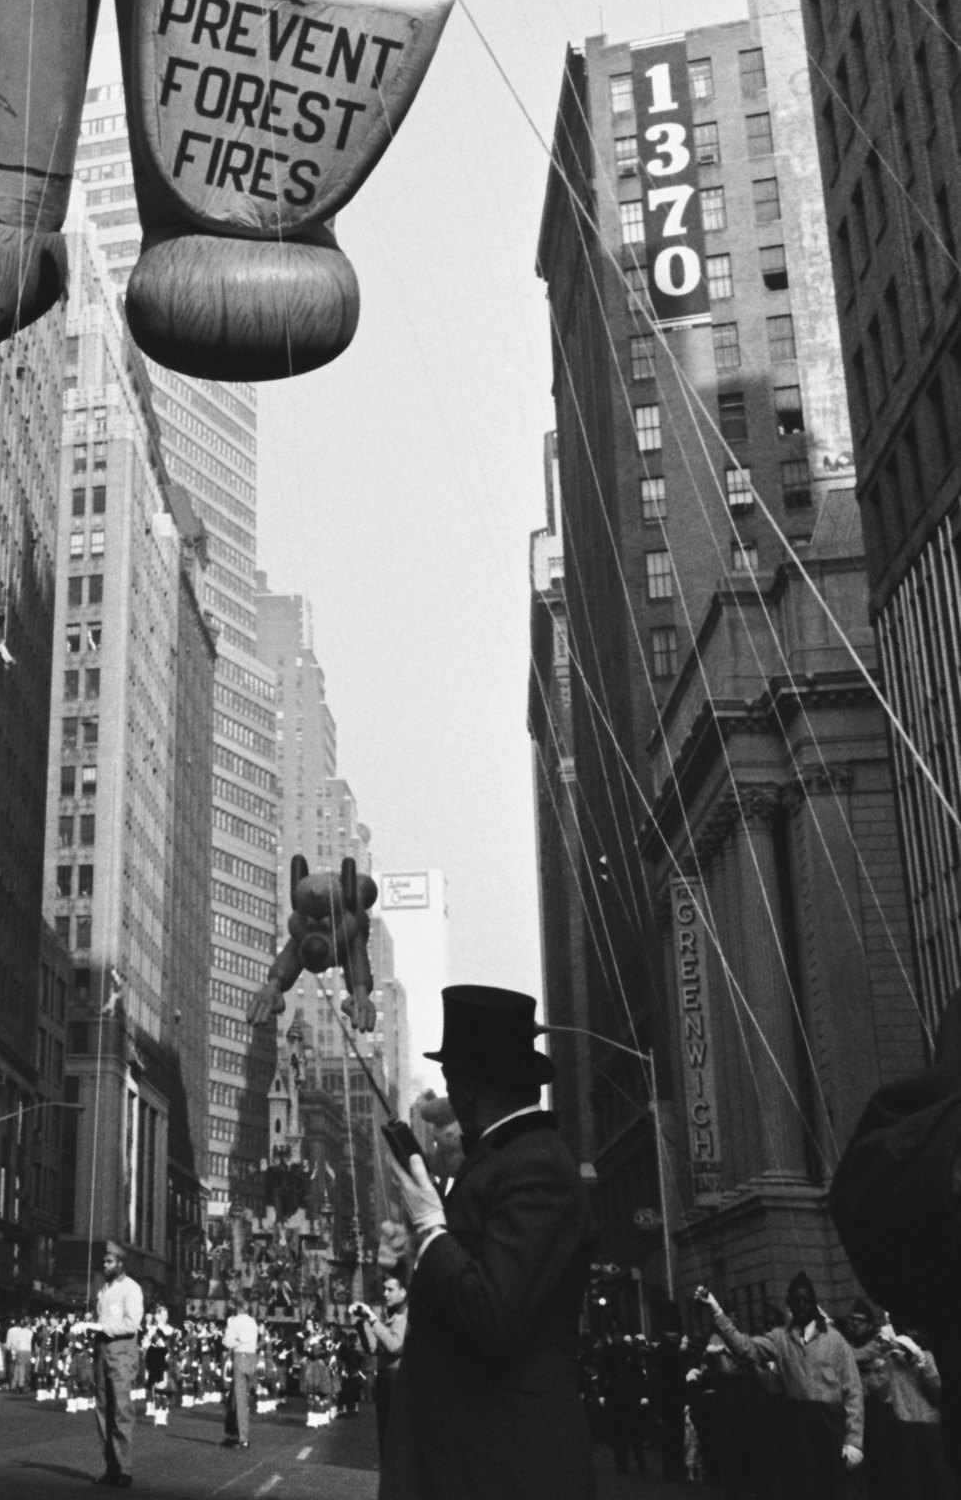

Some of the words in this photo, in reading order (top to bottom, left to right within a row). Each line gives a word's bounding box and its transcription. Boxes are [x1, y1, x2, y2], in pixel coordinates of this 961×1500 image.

[159, 55, 367, 151] FOREST
[172, 129, 321, 207] FIRES
[644, 62, 702, 297] 1370
[676, 902, 715, 1159] GREENWICH
